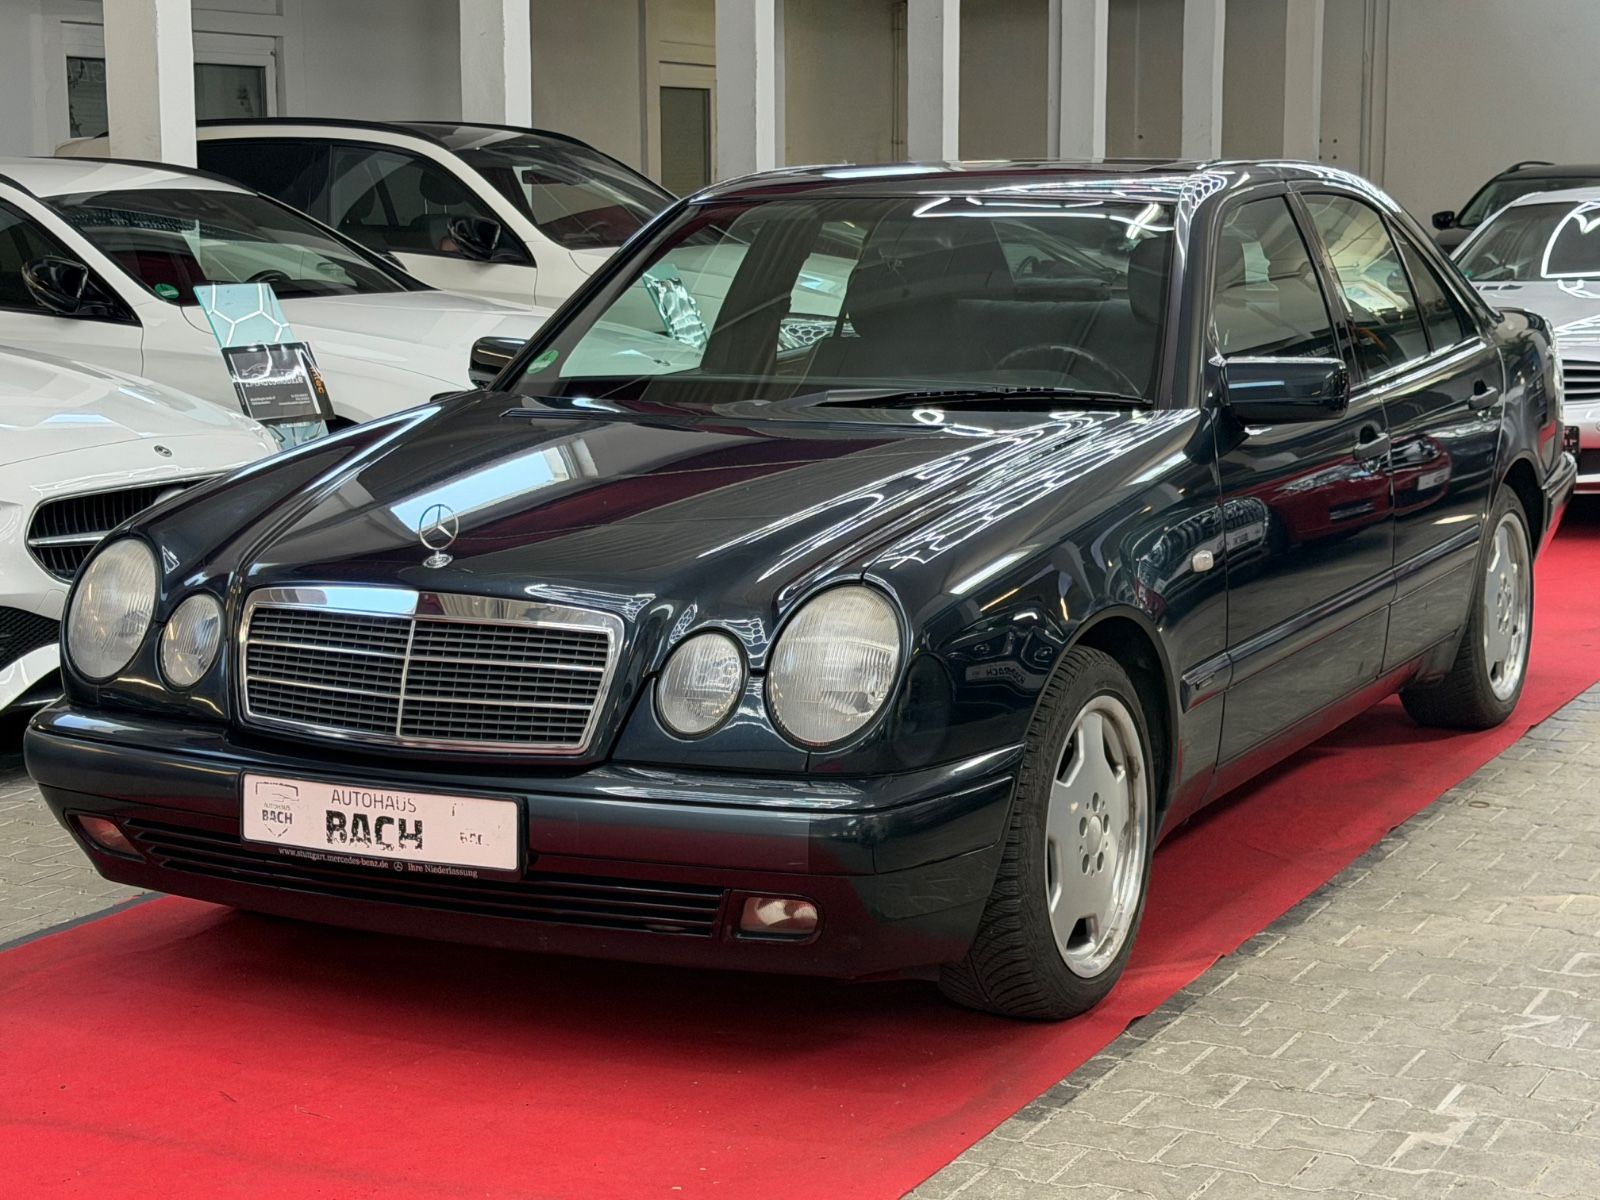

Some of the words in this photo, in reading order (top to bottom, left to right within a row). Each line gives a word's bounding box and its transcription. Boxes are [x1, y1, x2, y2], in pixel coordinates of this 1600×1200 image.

[331, 789, 417, 813] AUTOHAUS
[262, 809, 293, 825] BACH
[326, 810, 423, 851] BACH
[407, 863, 424, 873] Ihre
[425, 864, 478, 878] Niederlassung
